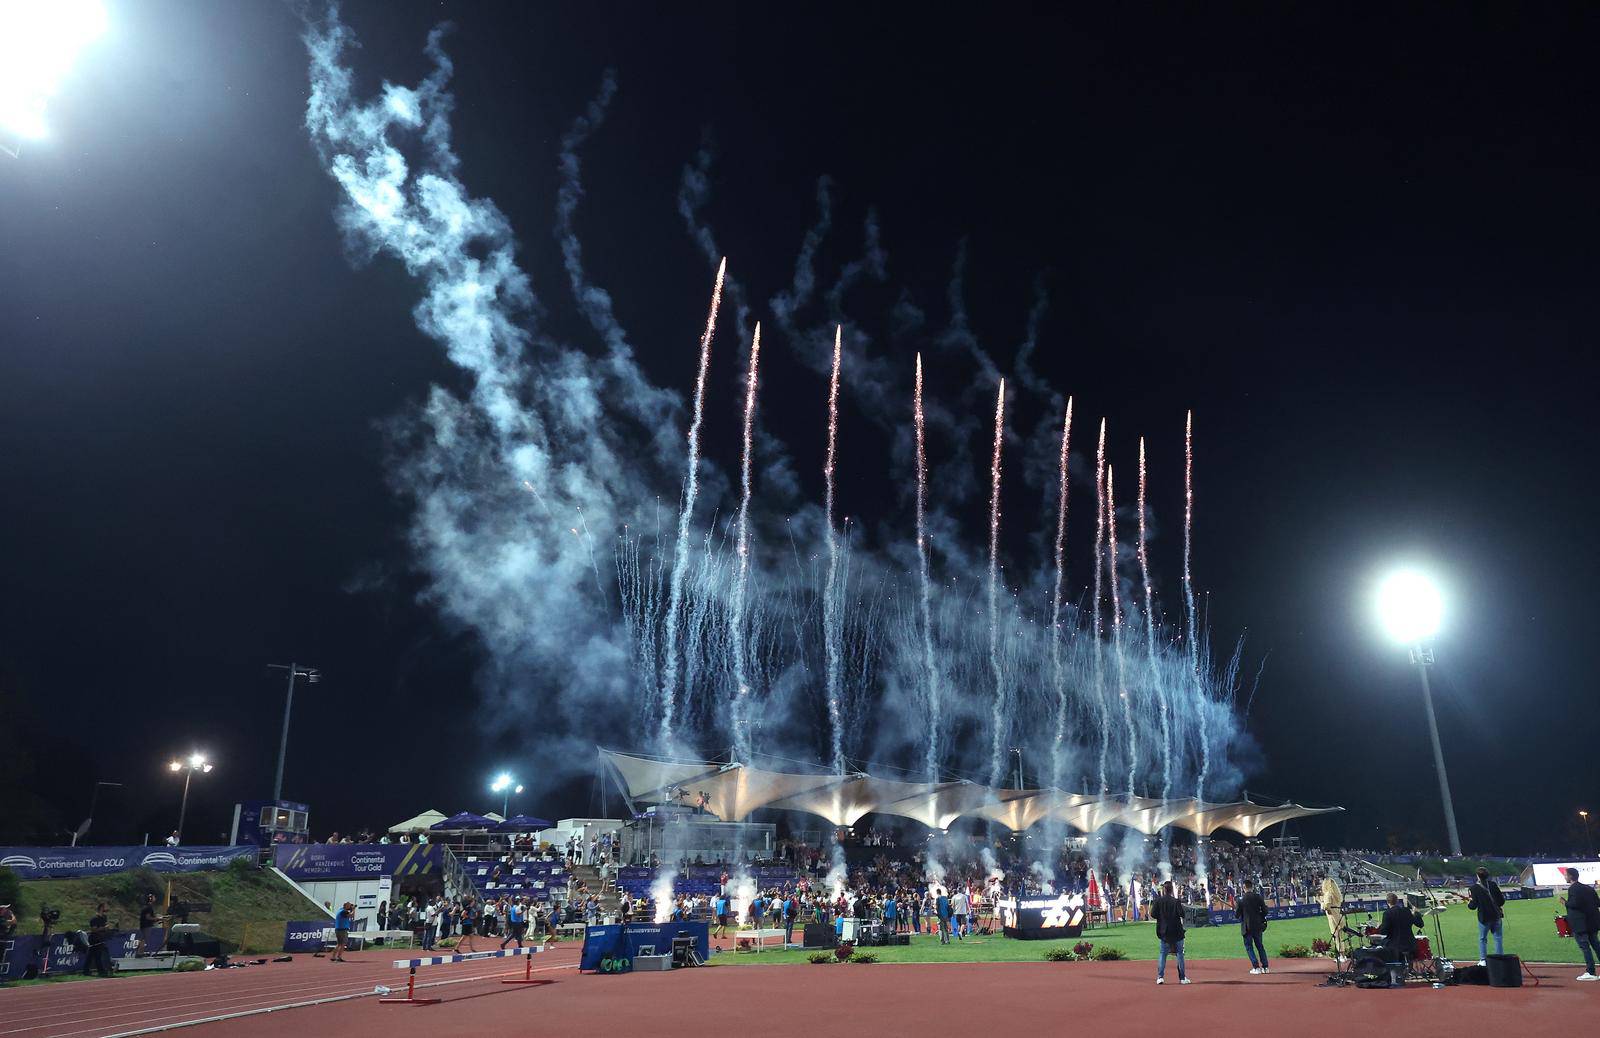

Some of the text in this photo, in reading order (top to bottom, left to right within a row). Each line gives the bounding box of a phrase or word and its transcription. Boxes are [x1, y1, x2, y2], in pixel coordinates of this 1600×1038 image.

[39, 858, 125, 869] Continental Tour GOLD
[178, 856, 218, 865] Continental
[351, 855, 386, 864] Continental
[354, 863, 383, 872] Tour Gold
[289, 929, 322, 942] zagreb
